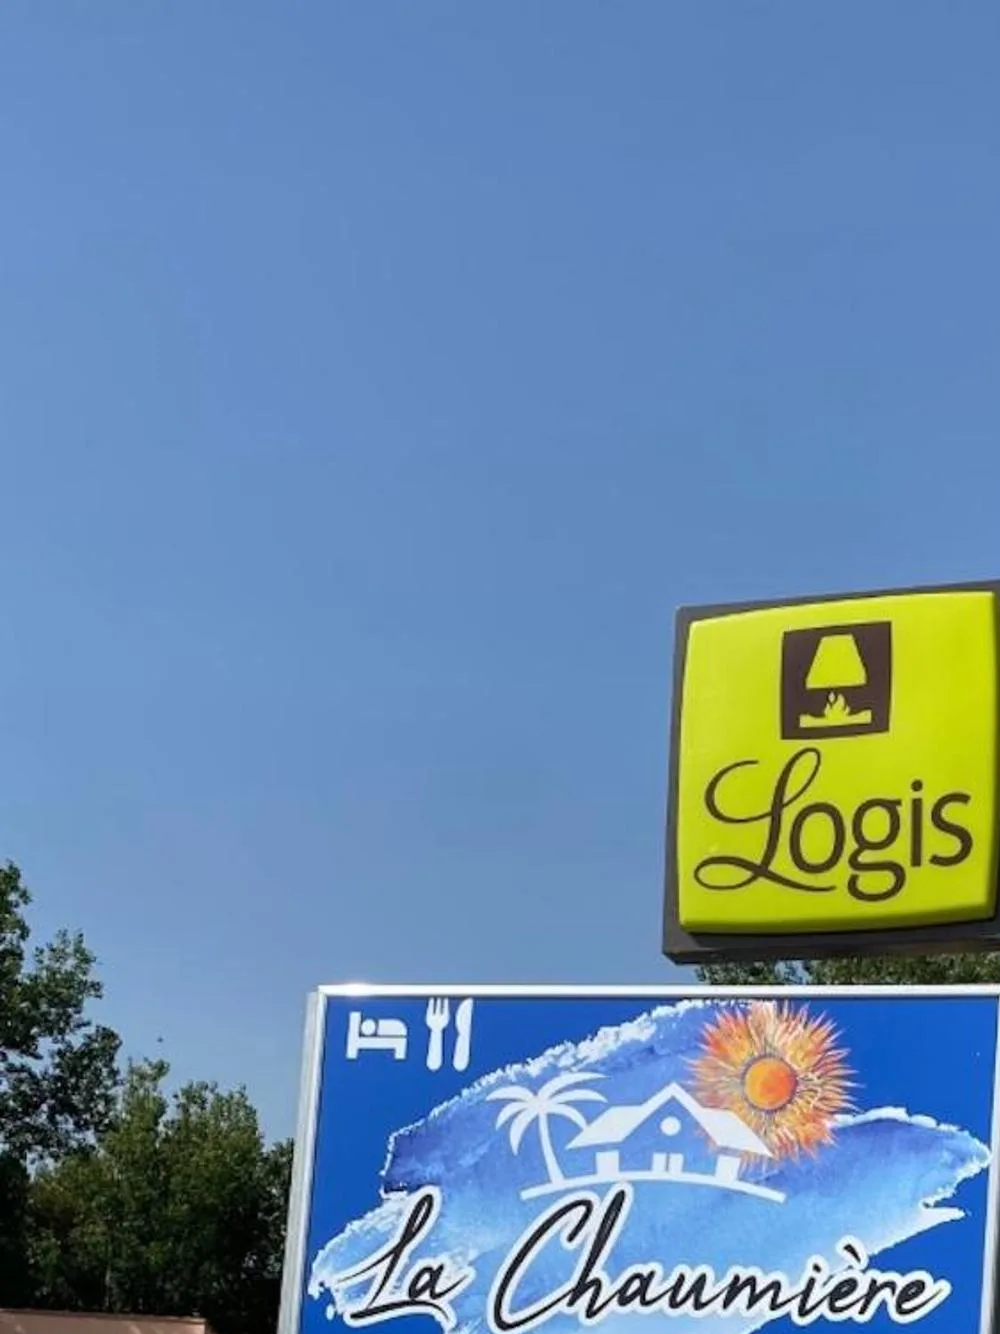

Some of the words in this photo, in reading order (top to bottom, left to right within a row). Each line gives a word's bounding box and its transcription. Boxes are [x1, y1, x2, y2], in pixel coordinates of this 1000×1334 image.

[694, 748, 973, 902] Logis
[335, 1194, 468, 1320] La
[493, 1190, 942, 1332] Chaumière
